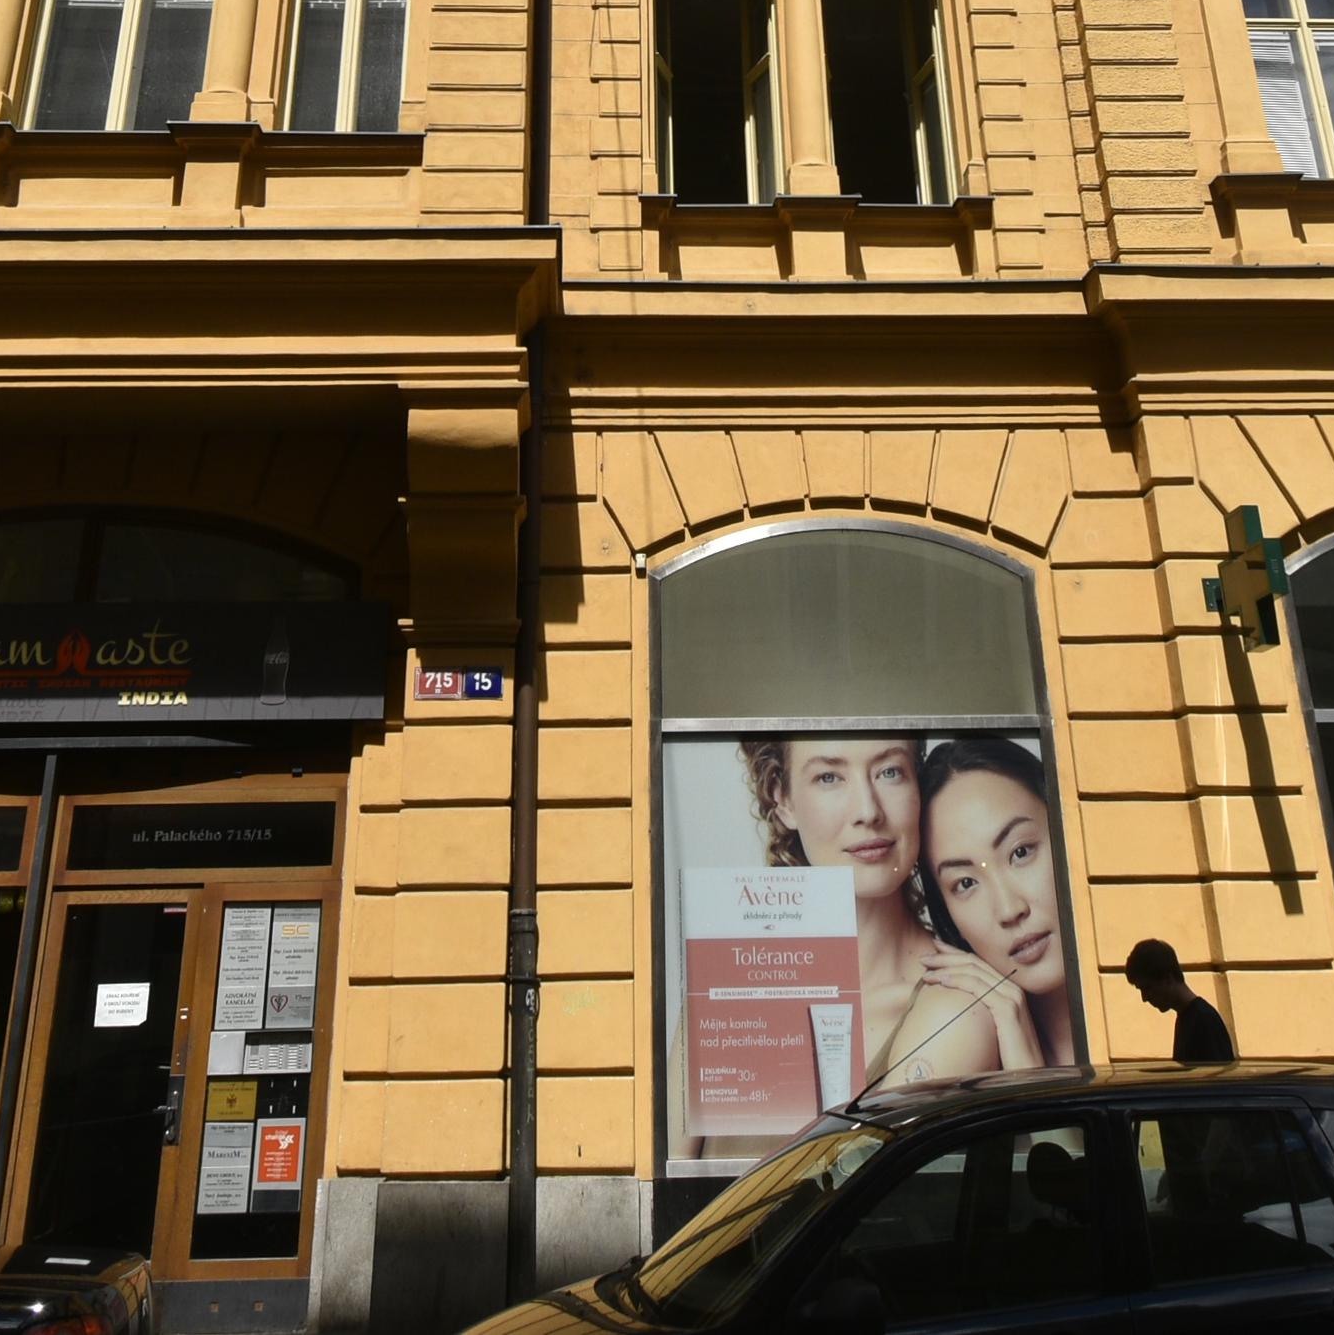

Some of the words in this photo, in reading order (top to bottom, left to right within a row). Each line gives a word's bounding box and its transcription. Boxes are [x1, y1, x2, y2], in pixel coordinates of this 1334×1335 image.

[425, 672, 454, 688] 715
[473, 672, 493, 691] 15
[117, 691, 188, 707] INDIA
[132, 830, 149, 843] ul.
[153, 828, 223, 843] Palackého
[226, 828, 273, 843] 715/15
[758, 875, 806, 883] THERMALE
[737, 885, 804, 907] Avène
[731, 946, 814, 966] Tolérance
[748, 969, 799, 981] CONTROL
[699, 1018, 727, 1033] Mějte
[729, 1017, 768, 1030] kontrolu
[699, 1036, 719, 1047] nad
[722, 1035, 779, 1050] přecitlivělou
